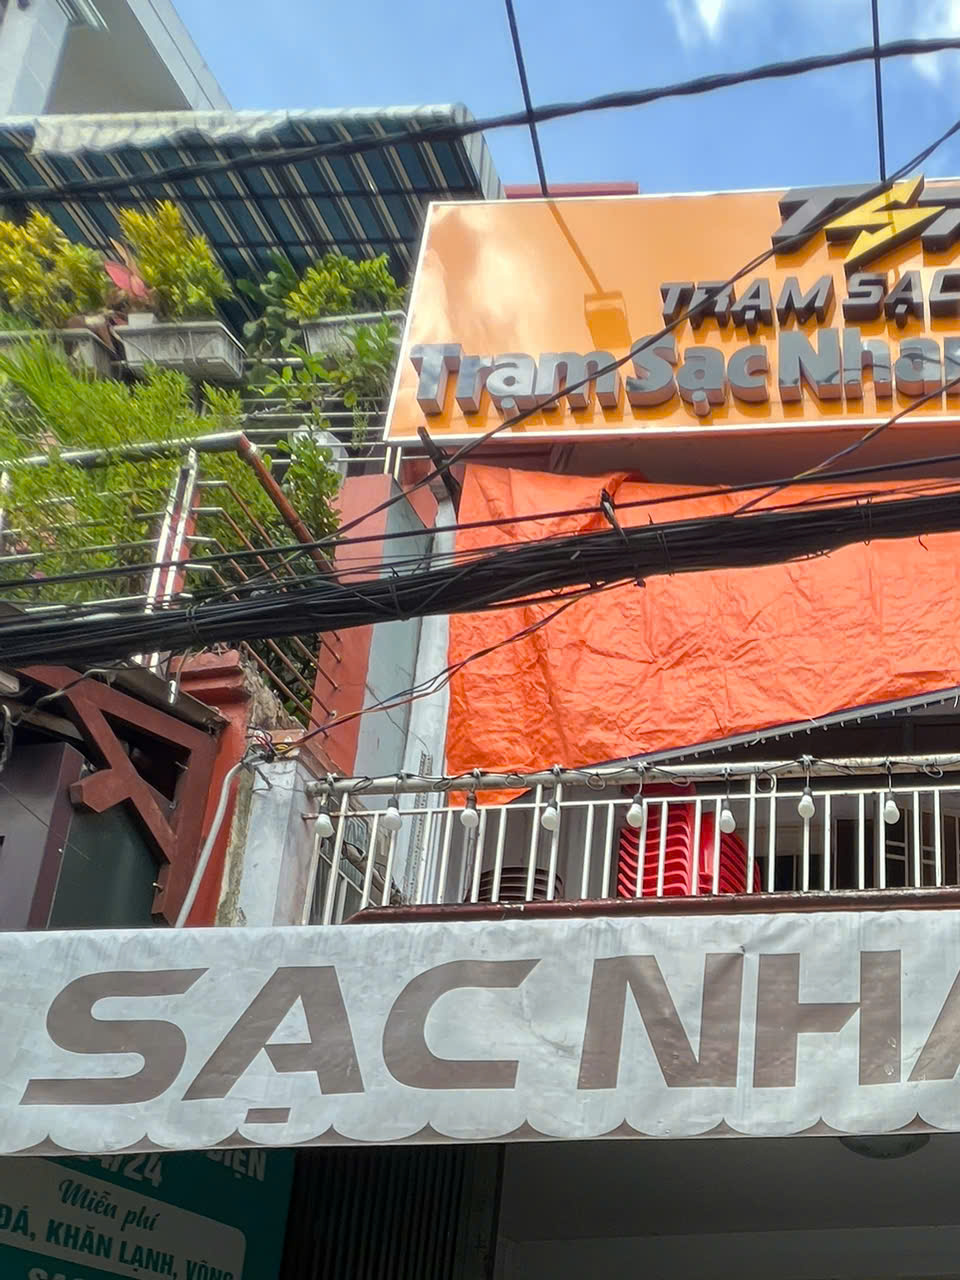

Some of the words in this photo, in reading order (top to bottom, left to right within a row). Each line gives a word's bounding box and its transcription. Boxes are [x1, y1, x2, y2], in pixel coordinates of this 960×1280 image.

[659, 273, 835, 336] TRẠM
[410, 342, 621, 421] Trạm
[625, 333, 770, 417] Sạc
[18, 957, 543, 1124] SẠC
[58, 1179, 117, 1219] Miễn
[121, 1205, 160, 1231] phí
[46, 1218, 112, 1259] KHĂN
[119, 1240, 178, 1280] LẠNH,
